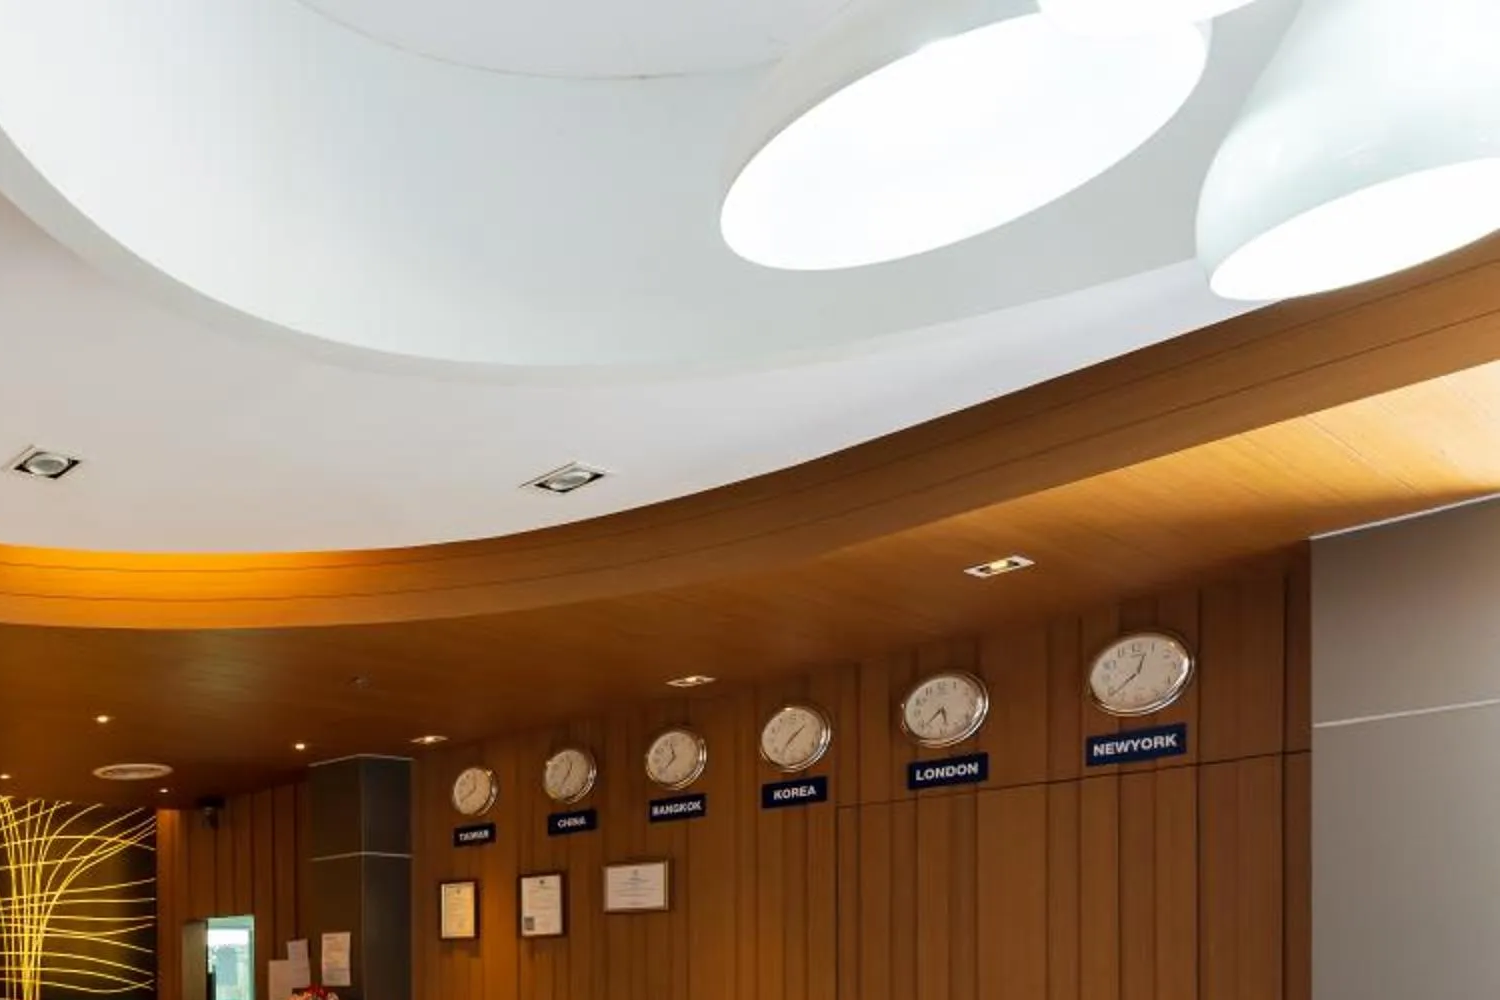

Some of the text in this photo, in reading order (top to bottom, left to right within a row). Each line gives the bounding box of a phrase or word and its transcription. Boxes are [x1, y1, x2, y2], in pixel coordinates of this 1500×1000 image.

[1093, 733, 1178, 757] NEWYORK
[915, 761, 979, 781] LONDON
[772, 784, 817, 801] KOREA
[651, 800, 703, 816] BANGKOK
[556, 815, 587, 829] CHINA
